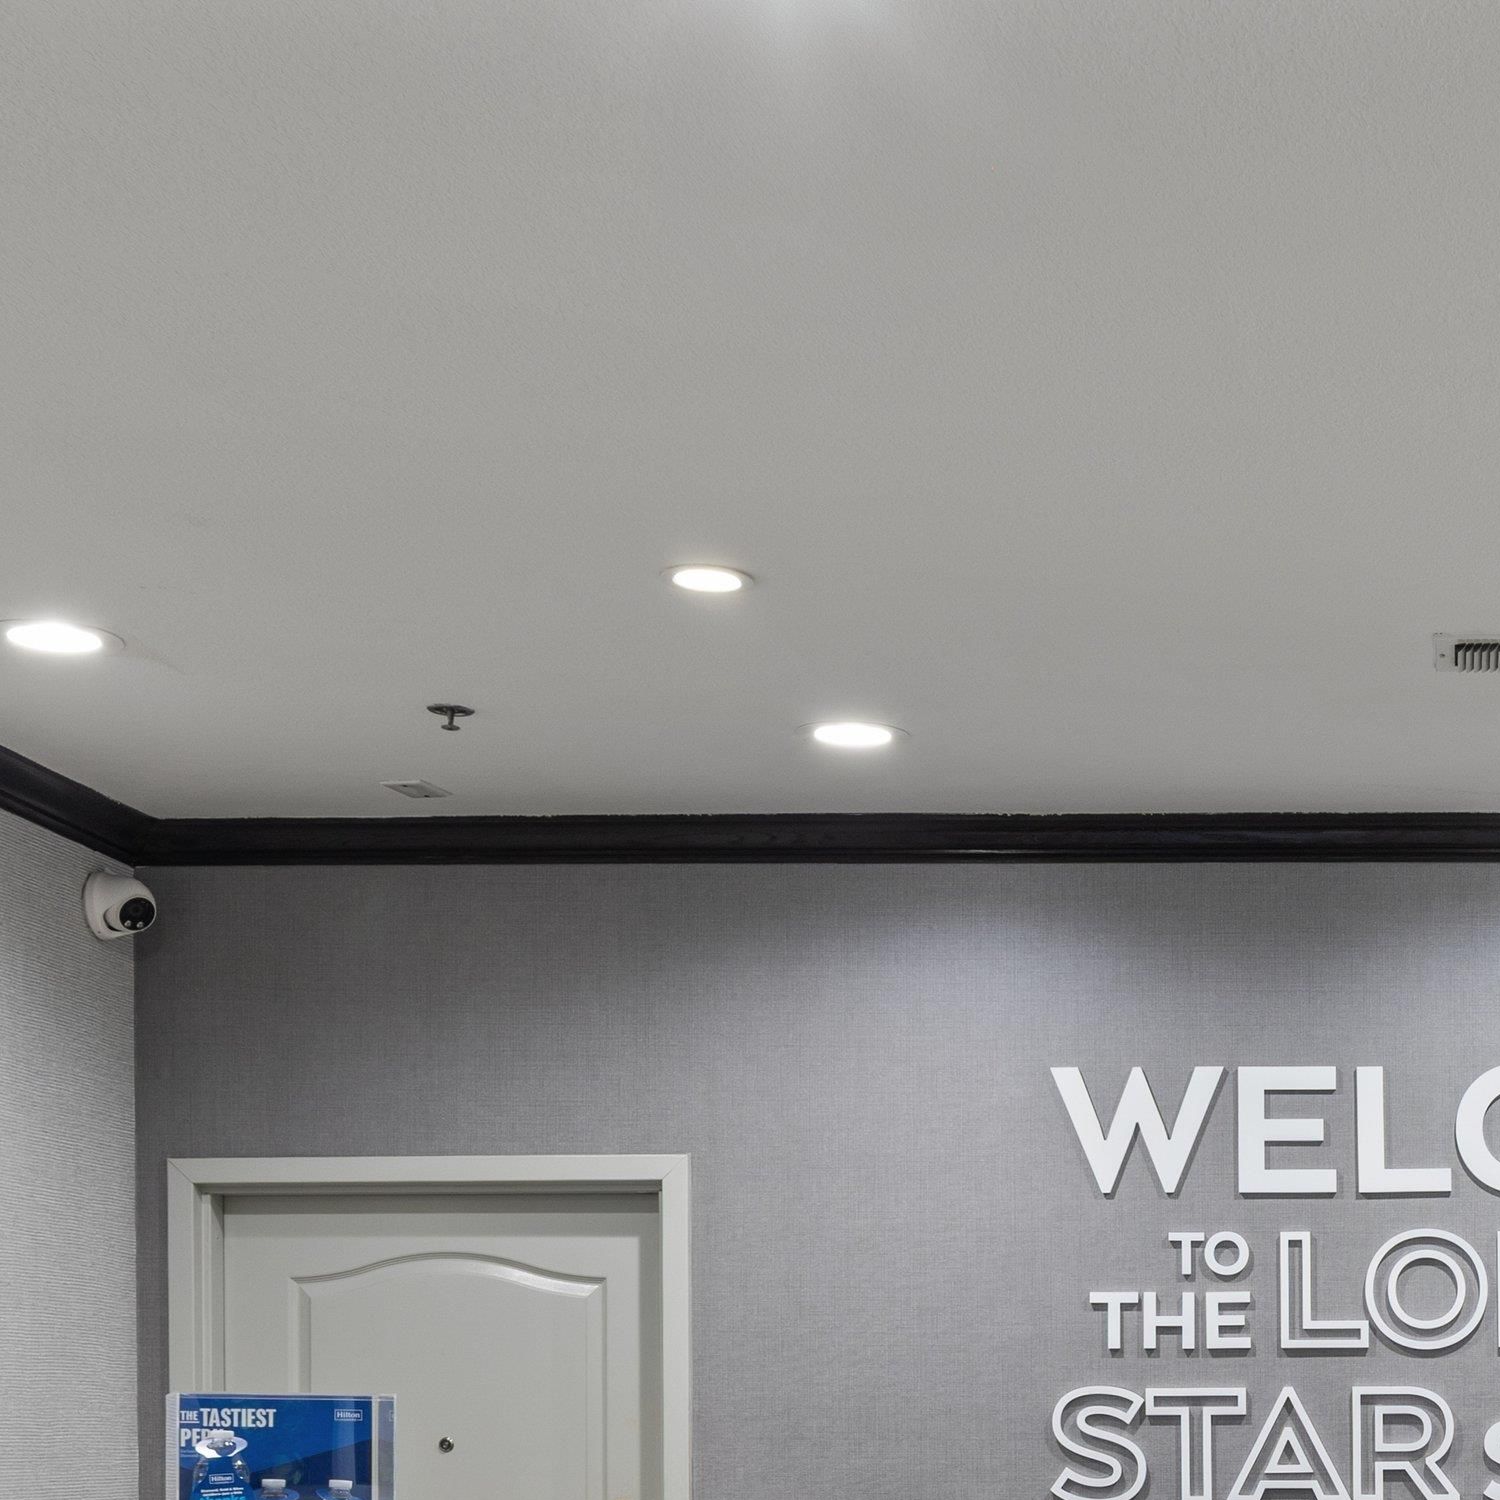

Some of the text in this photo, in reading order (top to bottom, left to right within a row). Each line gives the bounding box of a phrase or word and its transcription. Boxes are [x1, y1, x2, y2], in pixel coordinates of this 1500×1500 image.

[1168, 1231, 1250, 1276] TO
[1089, 1291, 1252, 1350] THE
[180, 1408, 277, 1428] THE TASTIEST
[336, 1411, 361, 1419] Hilton
